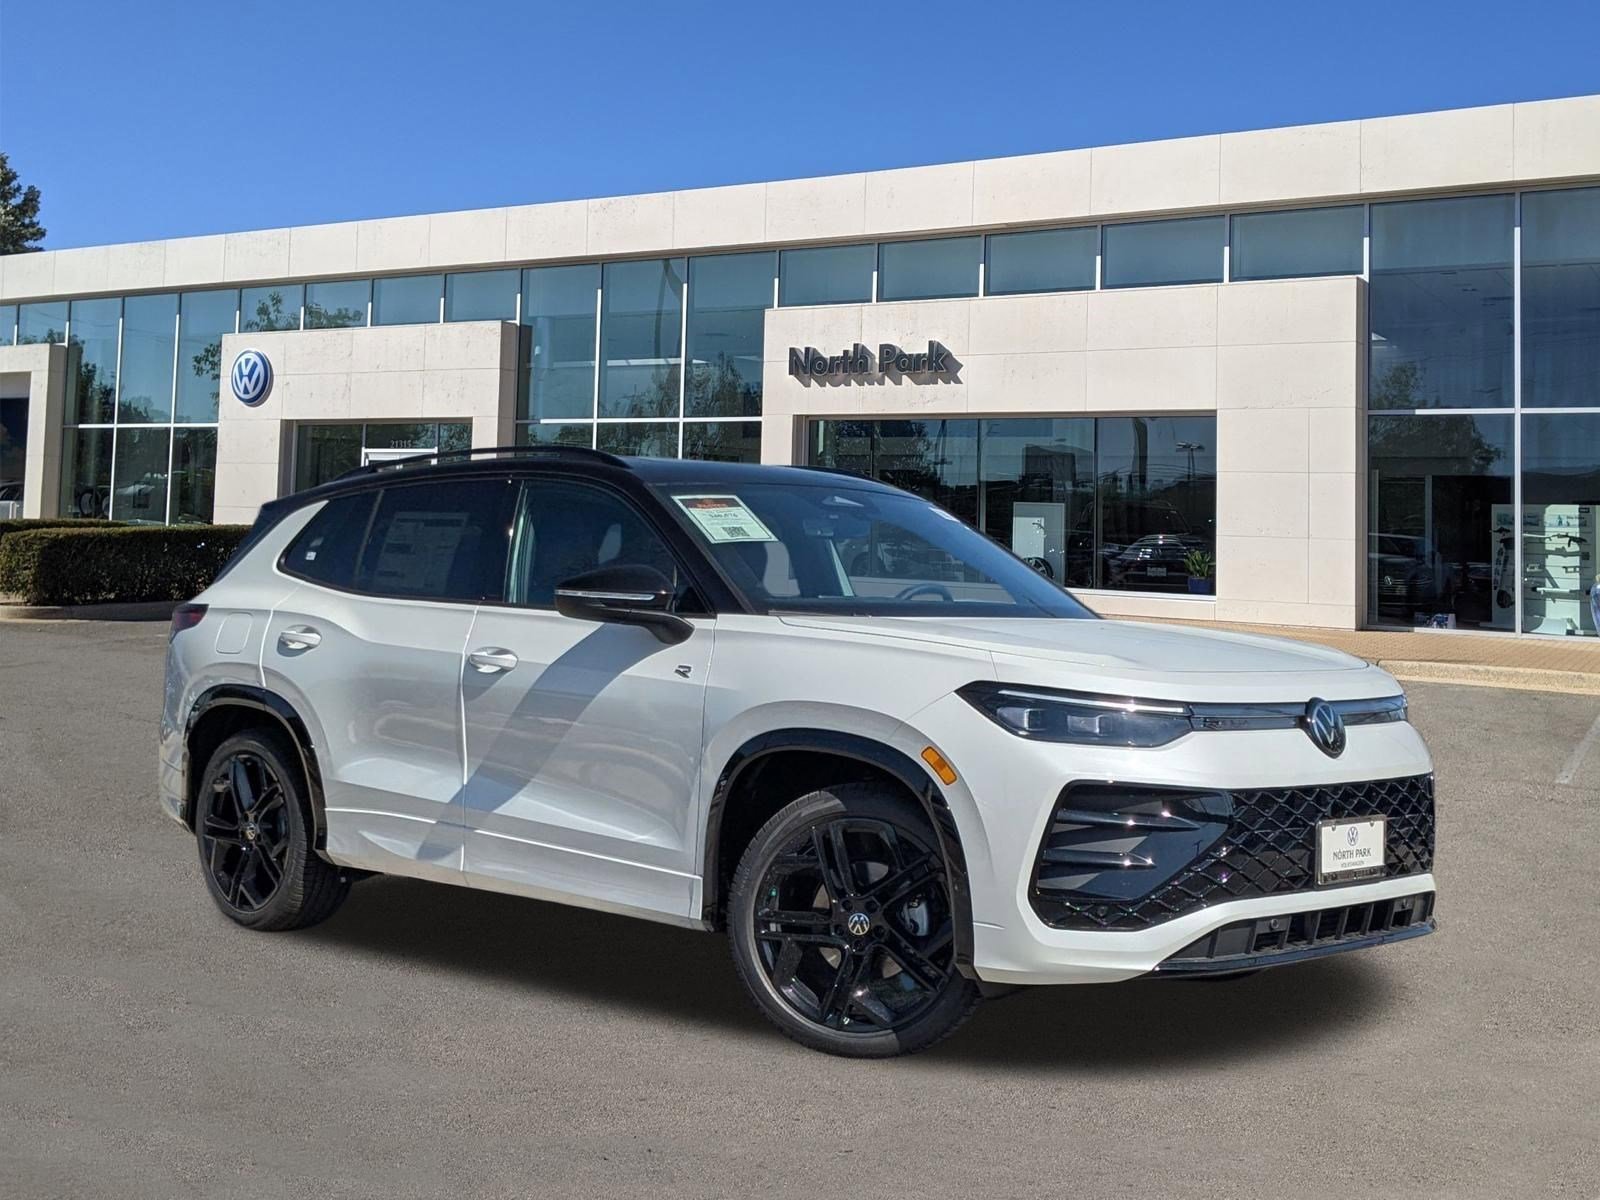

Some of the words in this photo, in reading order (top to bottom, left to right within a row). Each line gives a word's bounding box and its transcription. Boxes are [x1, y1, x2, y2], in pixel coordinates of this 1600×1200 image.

[789, 343, 872, 376] North
[878, 340, 947, 373] Park
[1332, 848, 1355, 861] NORTH
[1355, 848, 1372, 858] PARK
